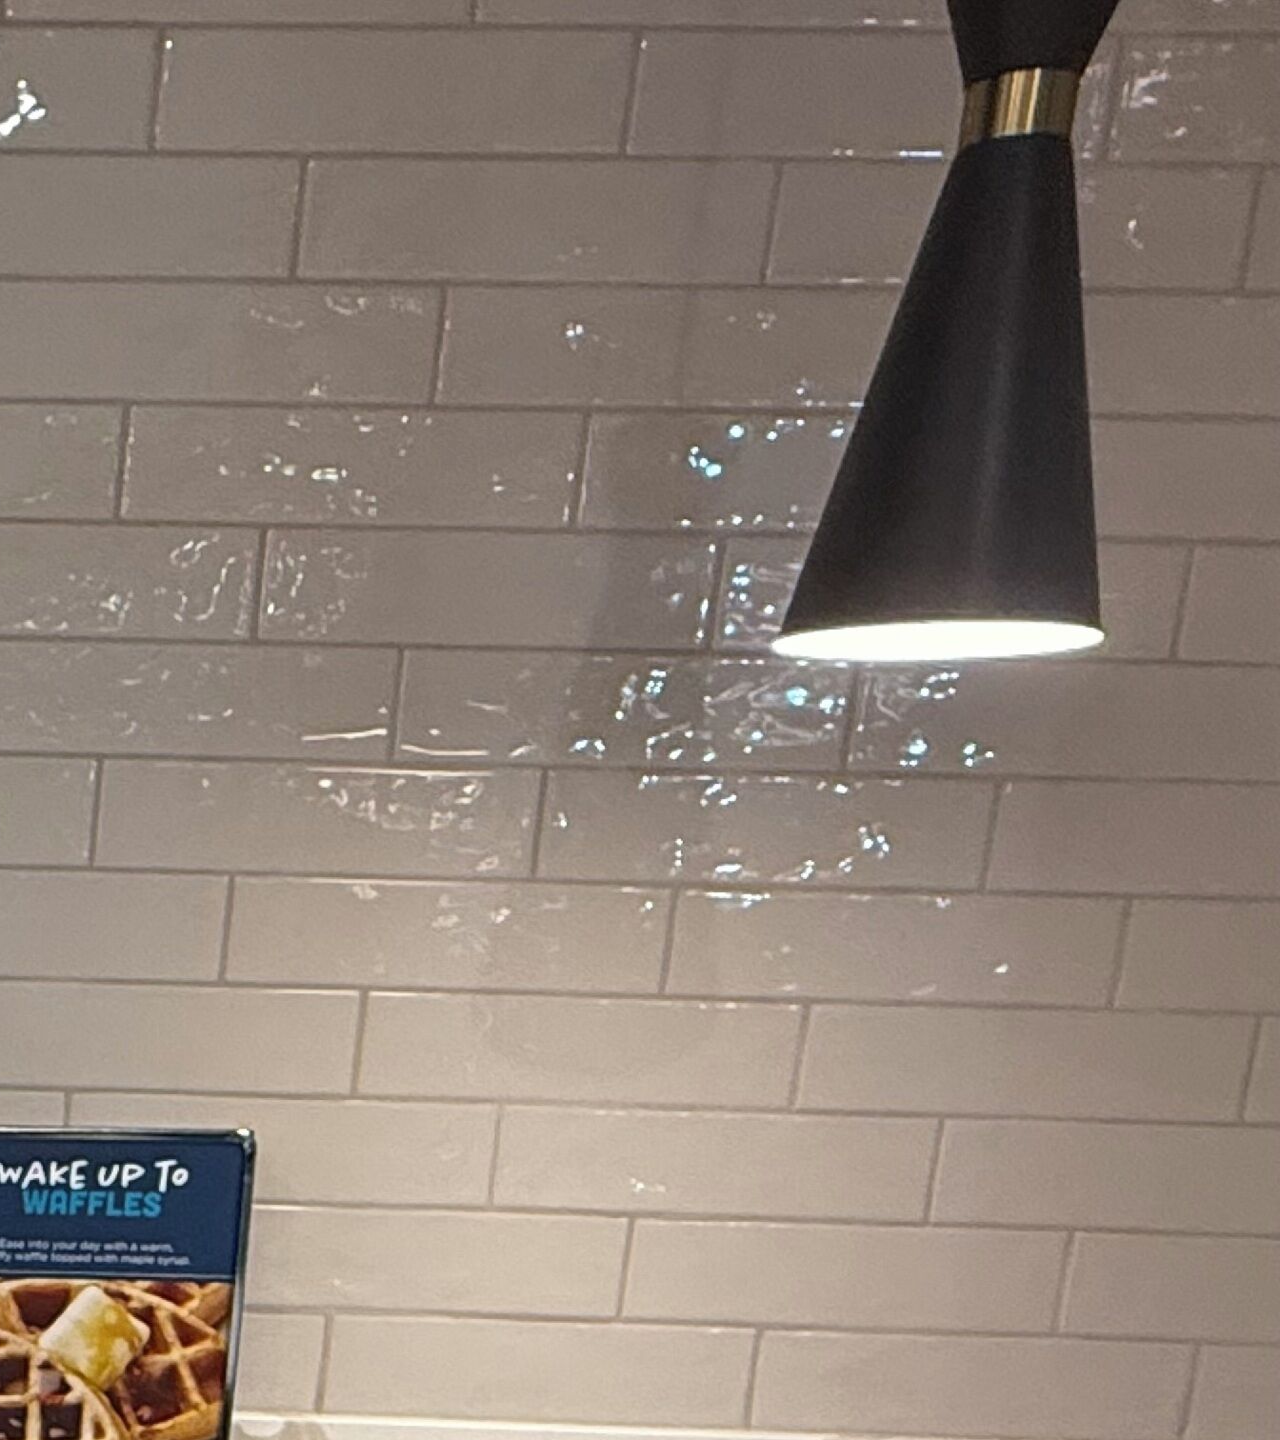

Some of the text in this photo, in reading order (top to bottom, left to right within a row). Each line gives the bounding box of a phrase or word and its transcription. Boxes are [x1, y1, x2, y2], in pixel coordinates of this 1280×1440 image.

[97, 1164, 145, 1188] UP
[21, 1189, 162, 1218] WAFFLES
[52, 1241, 78, 1252] your
[79, 1240, 101, 1252] day
[103, 1241, 128, 1252] with
[93, 1253, 119, 1263] with
